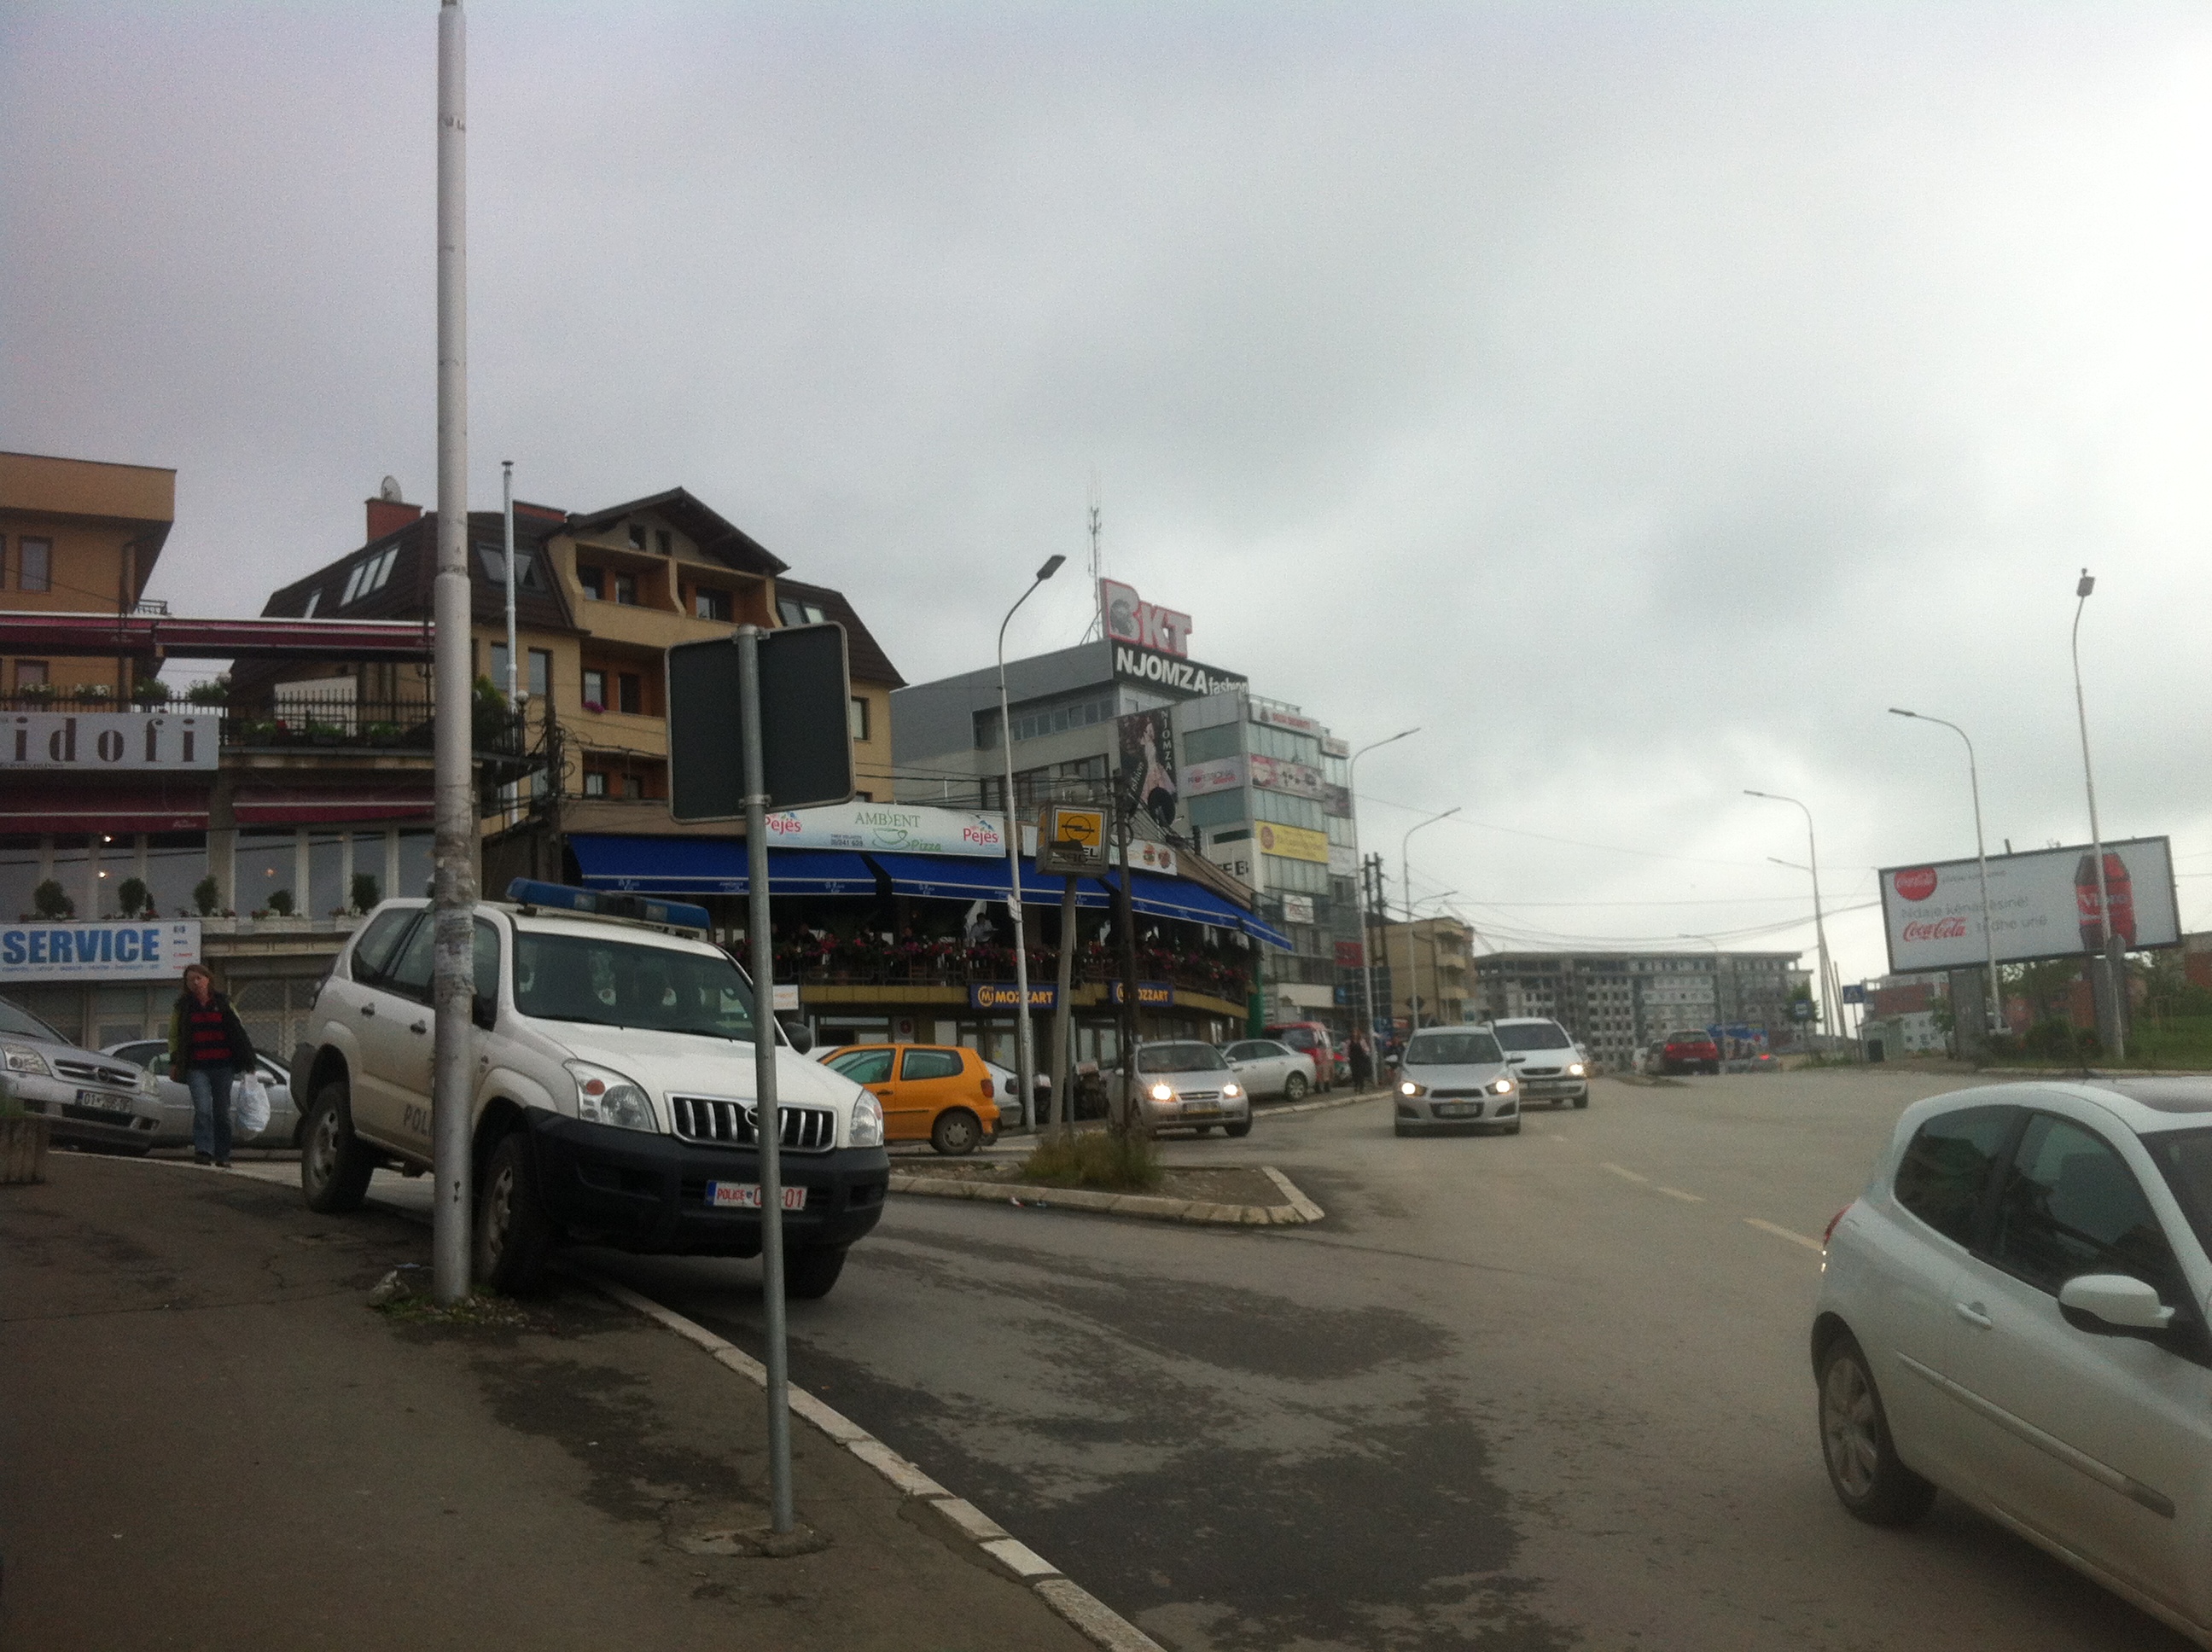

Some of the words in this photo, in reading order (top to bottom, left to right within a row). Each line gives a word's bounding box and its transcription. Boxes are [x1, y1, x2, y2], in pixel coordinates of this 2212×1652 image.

[1100, 578, 1192, 659] BKT
[1117, 647, 1208, 695] NJOMZA
[1161, 710, 1173, 771] NJOMZA
[911, 839, 942, 852] Pizza
[963, 828, 999, 846] Pejës
[3, 929, 160, 964] SERVICE
[717, 1188, 745, 1201] POLICE
